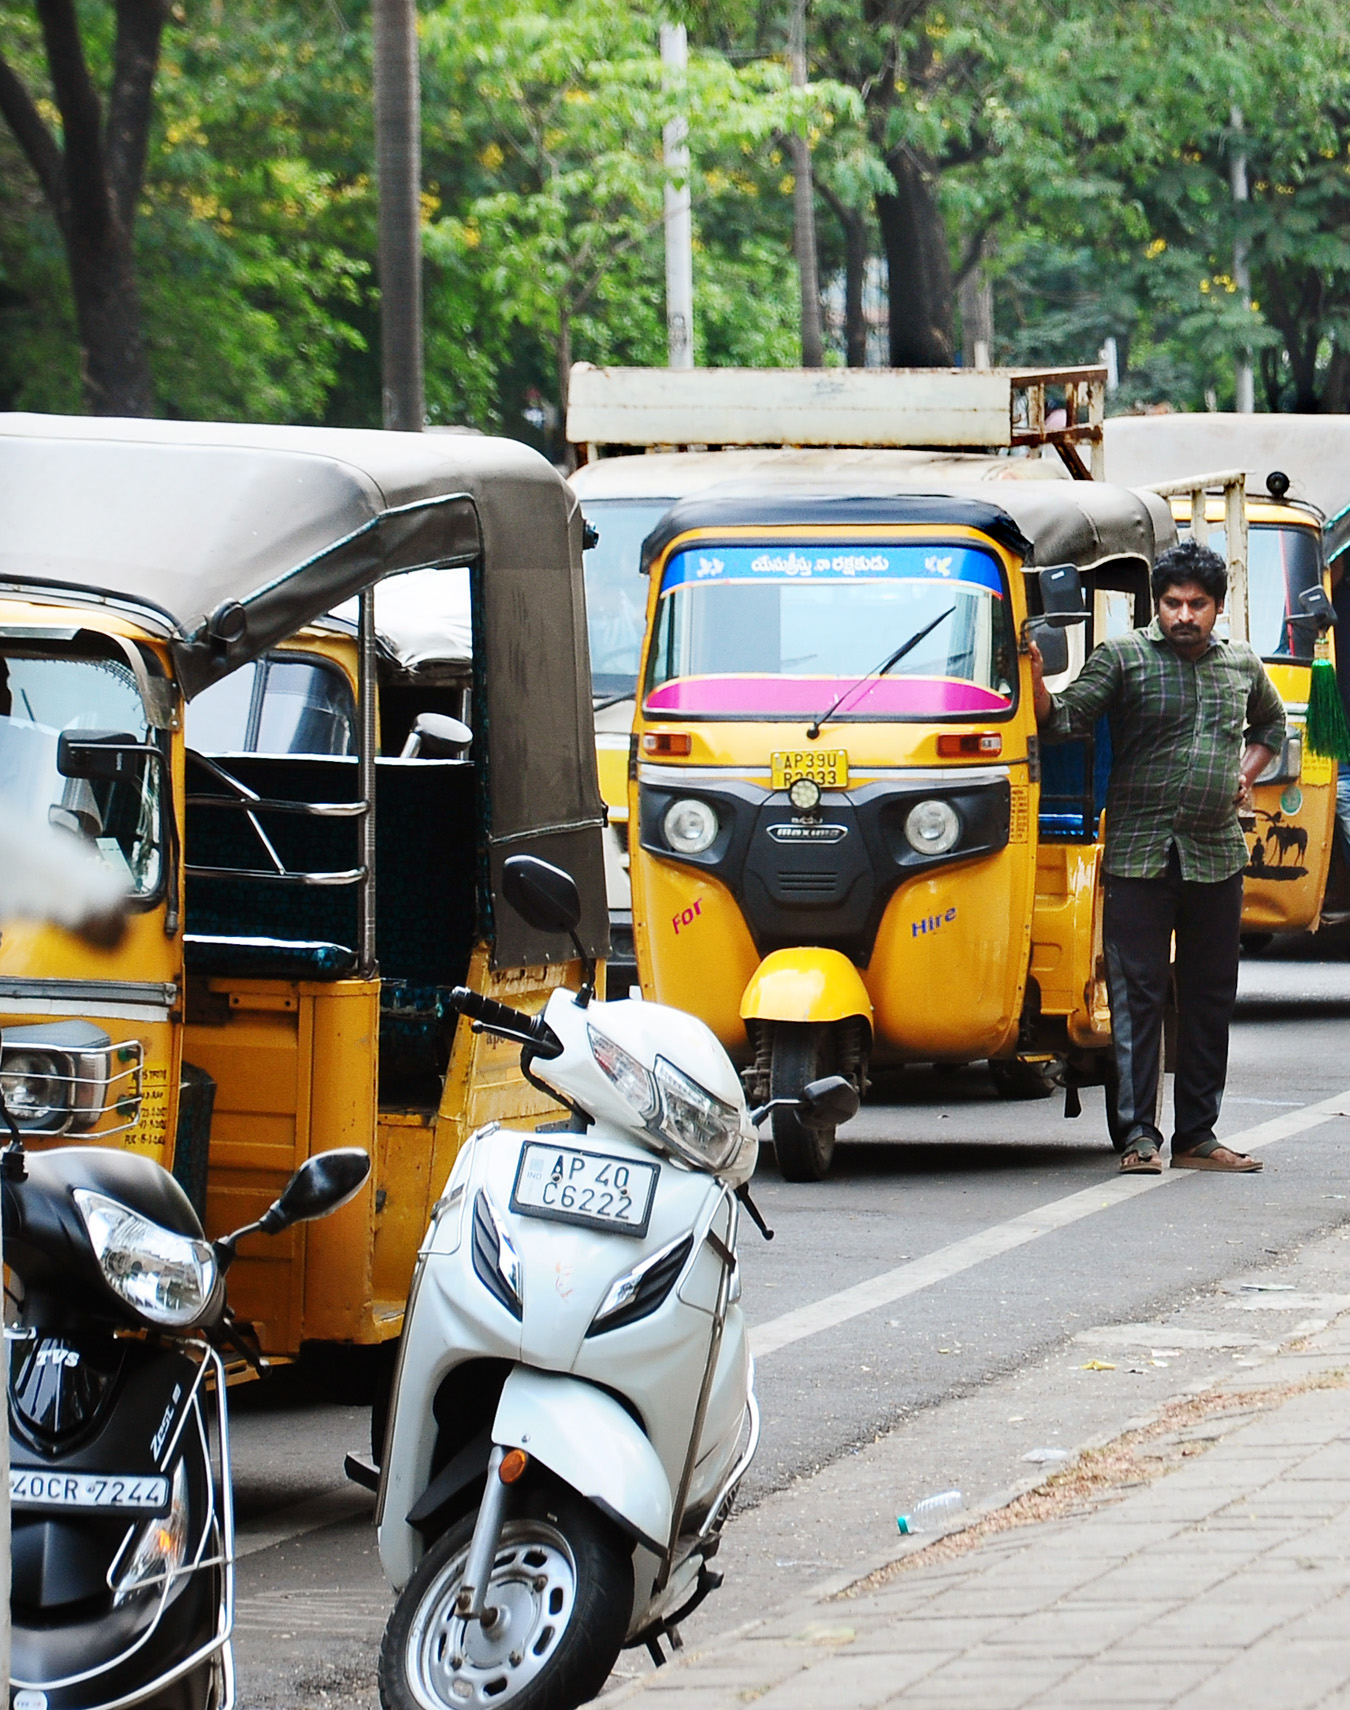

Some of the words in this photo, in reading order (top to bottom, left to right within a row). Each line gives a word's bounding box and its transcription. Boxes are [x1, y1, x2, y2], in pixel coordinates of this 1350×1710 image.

[783, 753, 837, 769] AP39U
[912, 907, 957, 938] Hire
[551, 1154, 586, 1181] AP
[594, 1163, 630, 1190] 40
[542, 1181, 633, 1220] C6222
[36, 1348, 80, 1368] TVS
[94, 1480, 160, 1505] 7244
